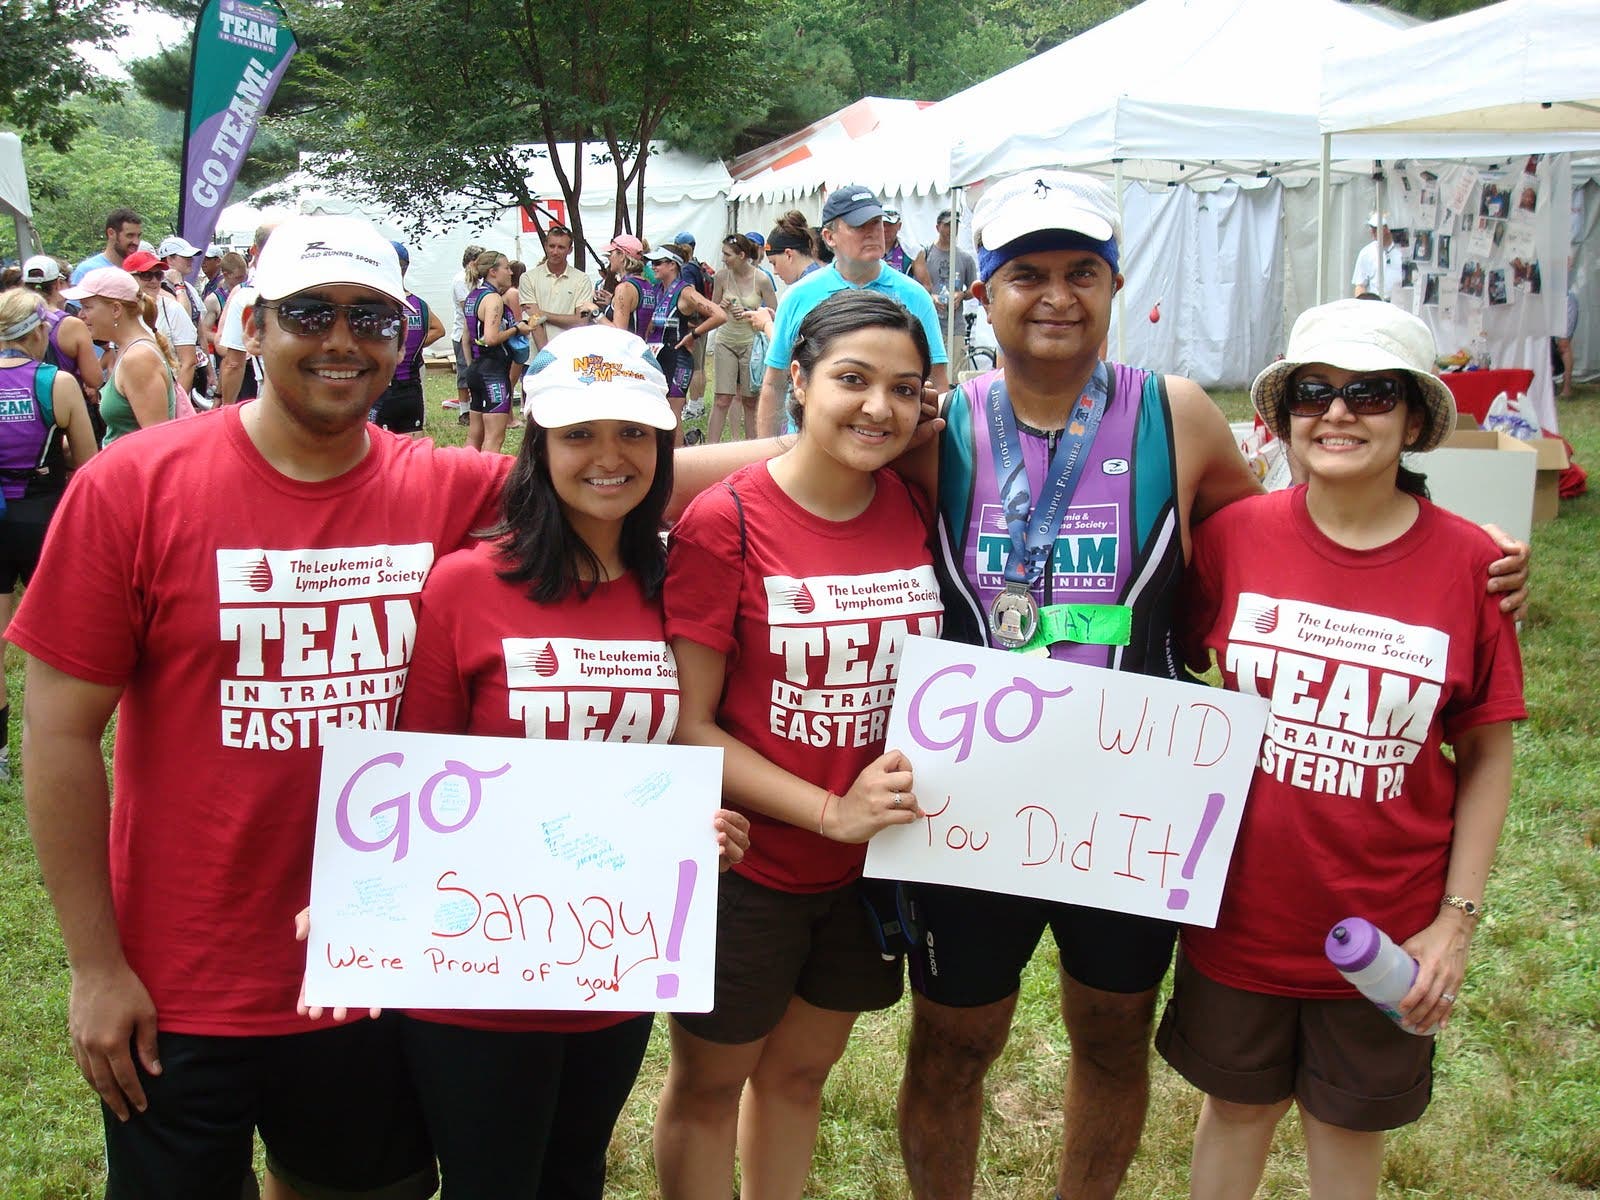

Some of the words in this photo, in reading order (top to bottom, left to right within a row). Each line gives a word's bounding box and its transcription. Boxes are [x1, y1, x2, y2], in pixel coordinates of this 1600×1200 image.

[219, 11, 278, 47] TEAM
[192, 158, 229, 208] GO
[212, 57, 274, 161] TEAM!
[322, 250, 354, 258] RUNNER
[355, 254, 381, 267] SPORTS
[0, 400, 33, 415] EAM
[999, 442, 1012, 469] 2010
[1039, 490, 1063, 535] OLYMPIC
[1056, 442, 1082, 488] FINISHER
[1074, 521, 1109, 530] Society
[289, 559, 313, 574] The
[314, 556, 383, 574] Leukemia
[386, 556, 394, 568] &
[978, 535, 1118, 574] TAM
[295, 574, 370, 593] Lymphoma
[376, 570, 426, 584] Society
[826, 584, 849, 596] The
[851, 578, 910, 596] Leukemia
[911, 578, 920, 588] &
[835, 596, 904, 612] Lymphoma
[1297, 611, 1322, 628] The
[1324, 618, 1393, 643] Leukemia
[1395, 632, 1406, 645] &
[573, 648, 596, 661] The
[599, 649, 660, 663] Leukemia
[662, 651, 669, 663] &
[1297, 627, 1377, 654] Lymphoma
[1381, 644, 1434, 668] Society
[580, 662, 652, 678] Lymphoma
[227, 686, 260, 702] IN
[280, 674, 406, 703] TRAININ
[777, 686, 803, 706] IN
[1226, 642, 1442, 745] TEAM
[770, 705, 891, 749] EASTER
[1256, 738, 1365, 800] STERN
[1375, 764, 1405, 803] PA
[923, 795, 990, 852] You
[1016, 805, 1099, 872] Did
[327, 942, 404, 971] We're
[424, 947, 500, 976] Proud
[522, 960, 554, 983] of
